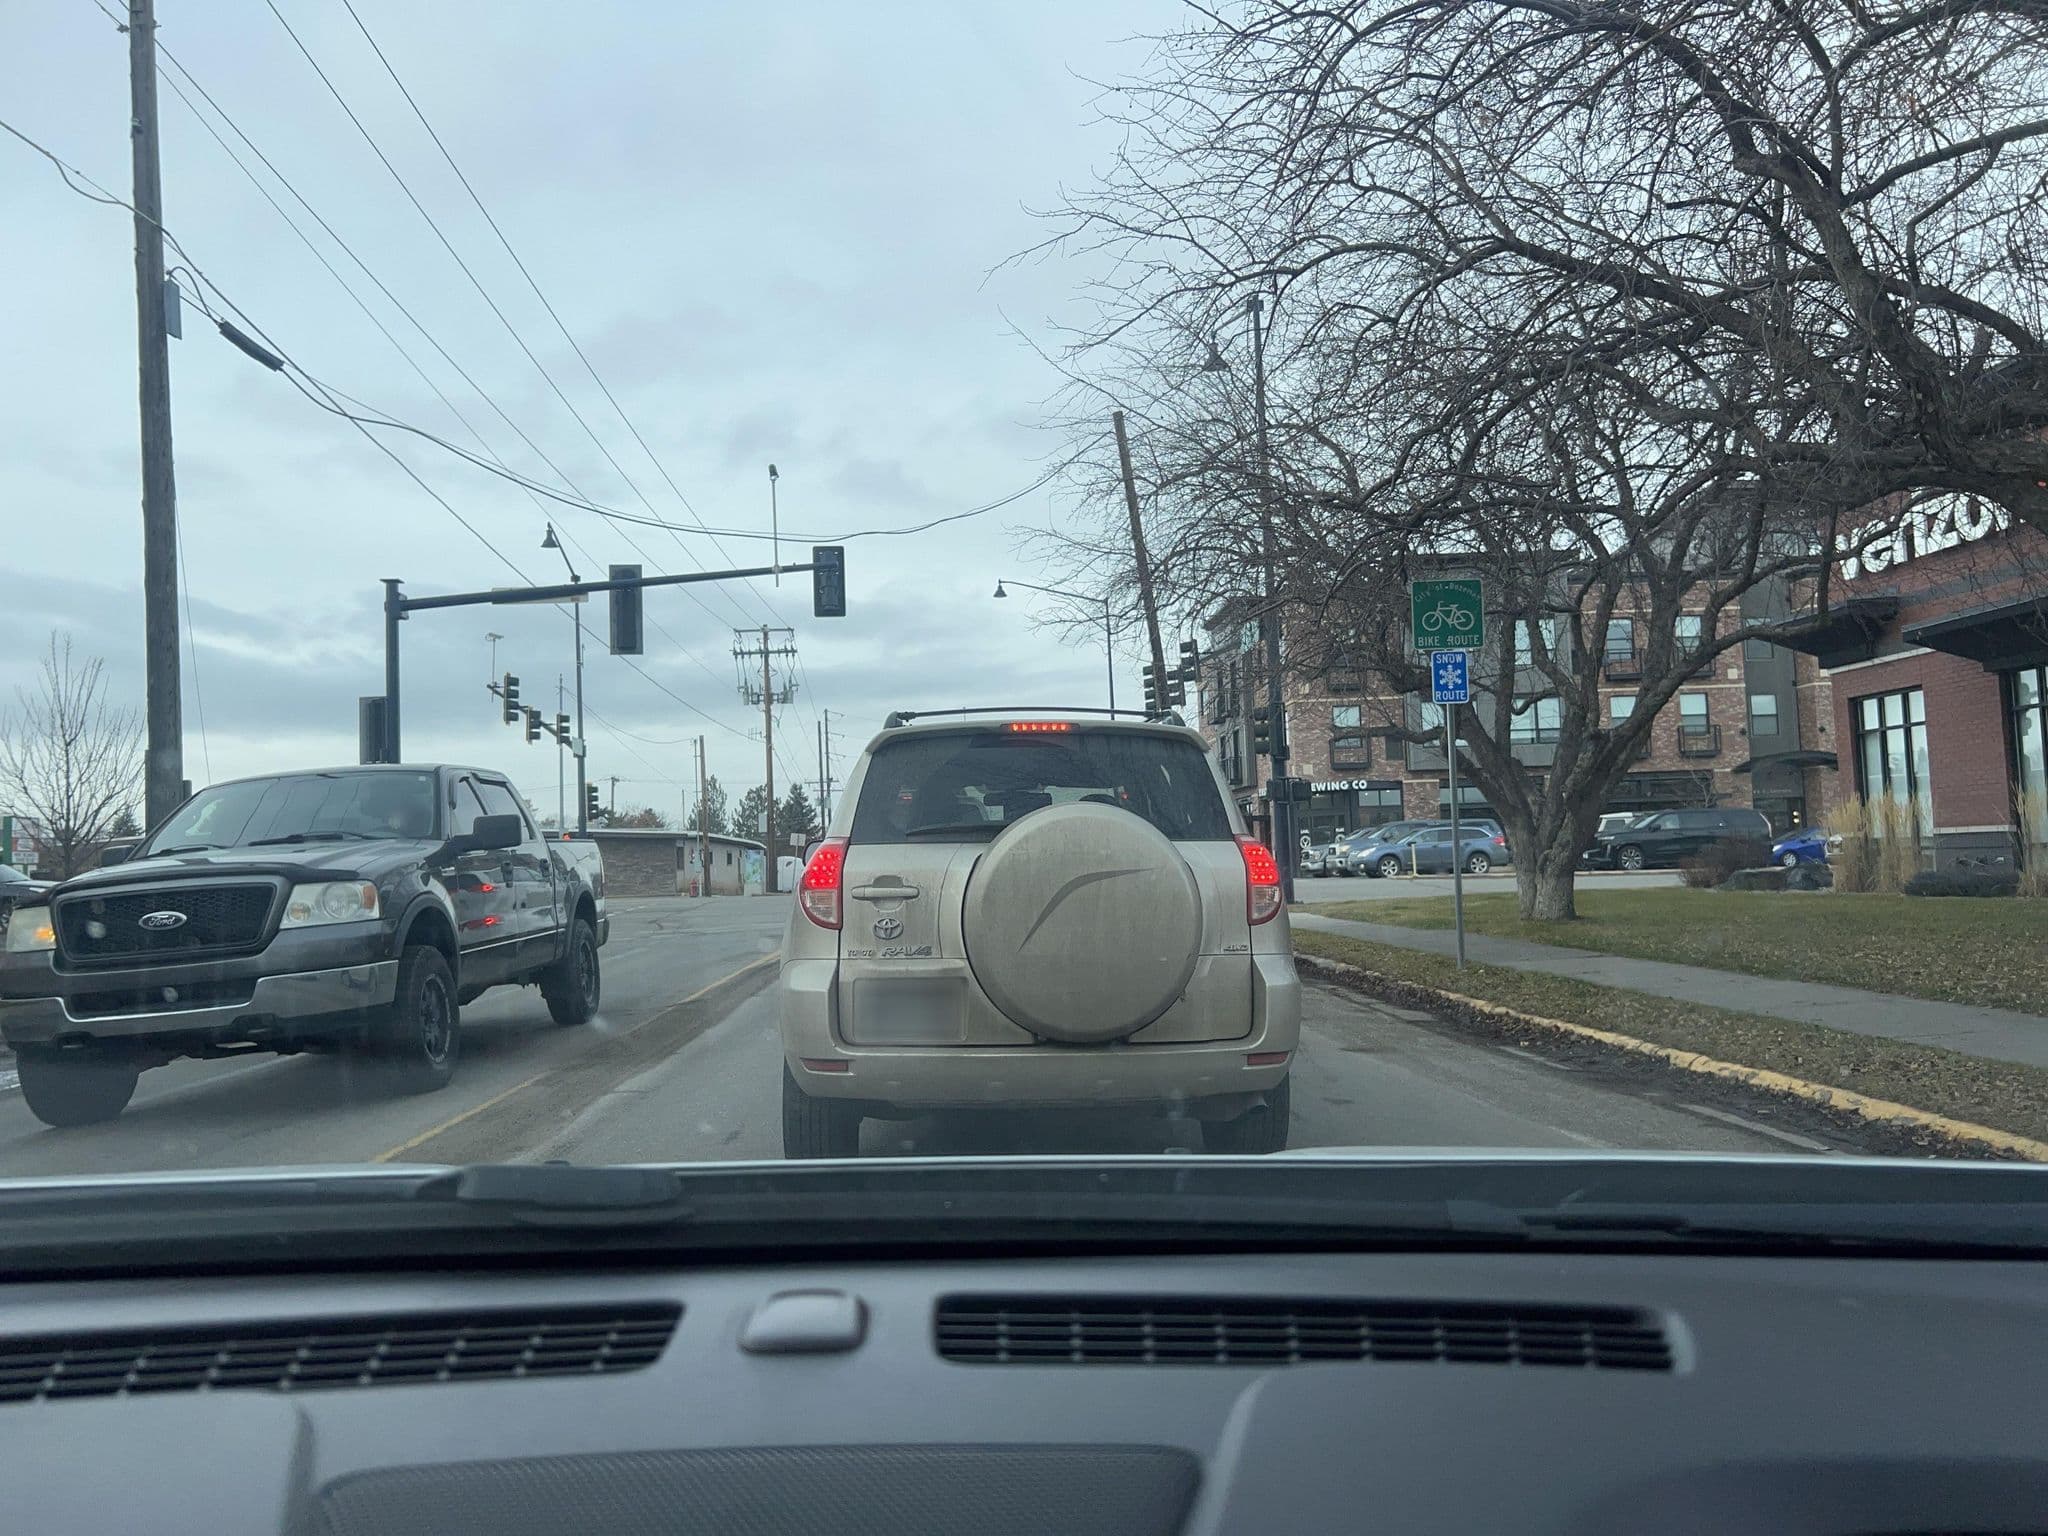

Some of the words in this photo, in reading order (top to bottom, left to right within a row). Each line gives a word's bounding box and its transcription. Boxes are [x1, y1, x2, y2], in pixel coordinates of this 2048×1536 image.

[1418, 635, 1440, 647] BIKE
[1447, 634, 1480, 646] ROUTE
[1436, 653, 1463, 664] SNOW
[1436, 690, 1466, 701] ROUTE
[1310, 780, 1349, 792] EWING
[1352, 779, 1368, 790] CO
[148, 915, 176, 926] Ford
[881, 945, 933, 957] RAV4
